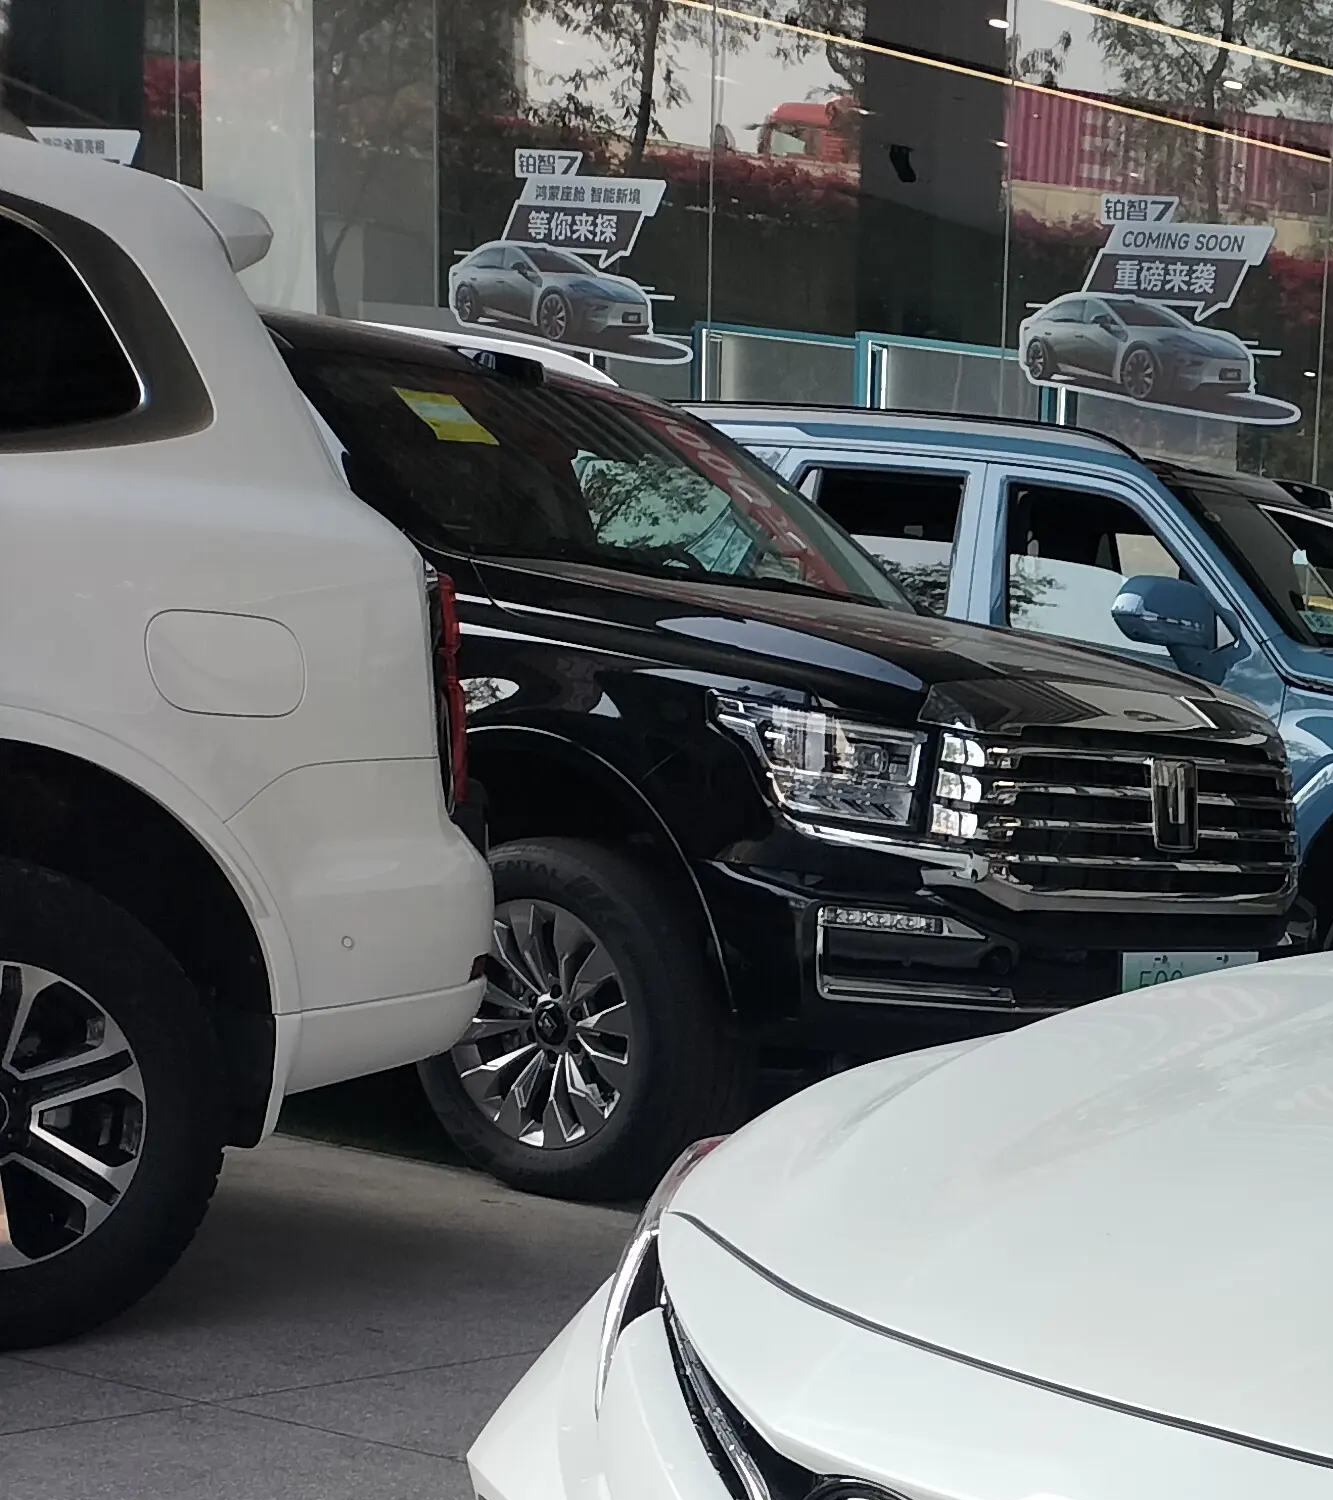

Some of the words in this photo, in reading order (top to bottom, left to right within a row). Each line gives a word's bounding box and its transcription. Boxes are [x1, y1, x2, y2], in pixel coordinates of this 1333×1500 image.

[518, 152, 579, 175] 铂智7
[1104, 198, 1174, 223] 铂智7
[527, 209, 618, 243] 等你来探
[1121, 229, 1190, 251] COMING
[1194, 234, 1245, 253] SOON
[1113, 259, 1217, 295] 重磅来袭
